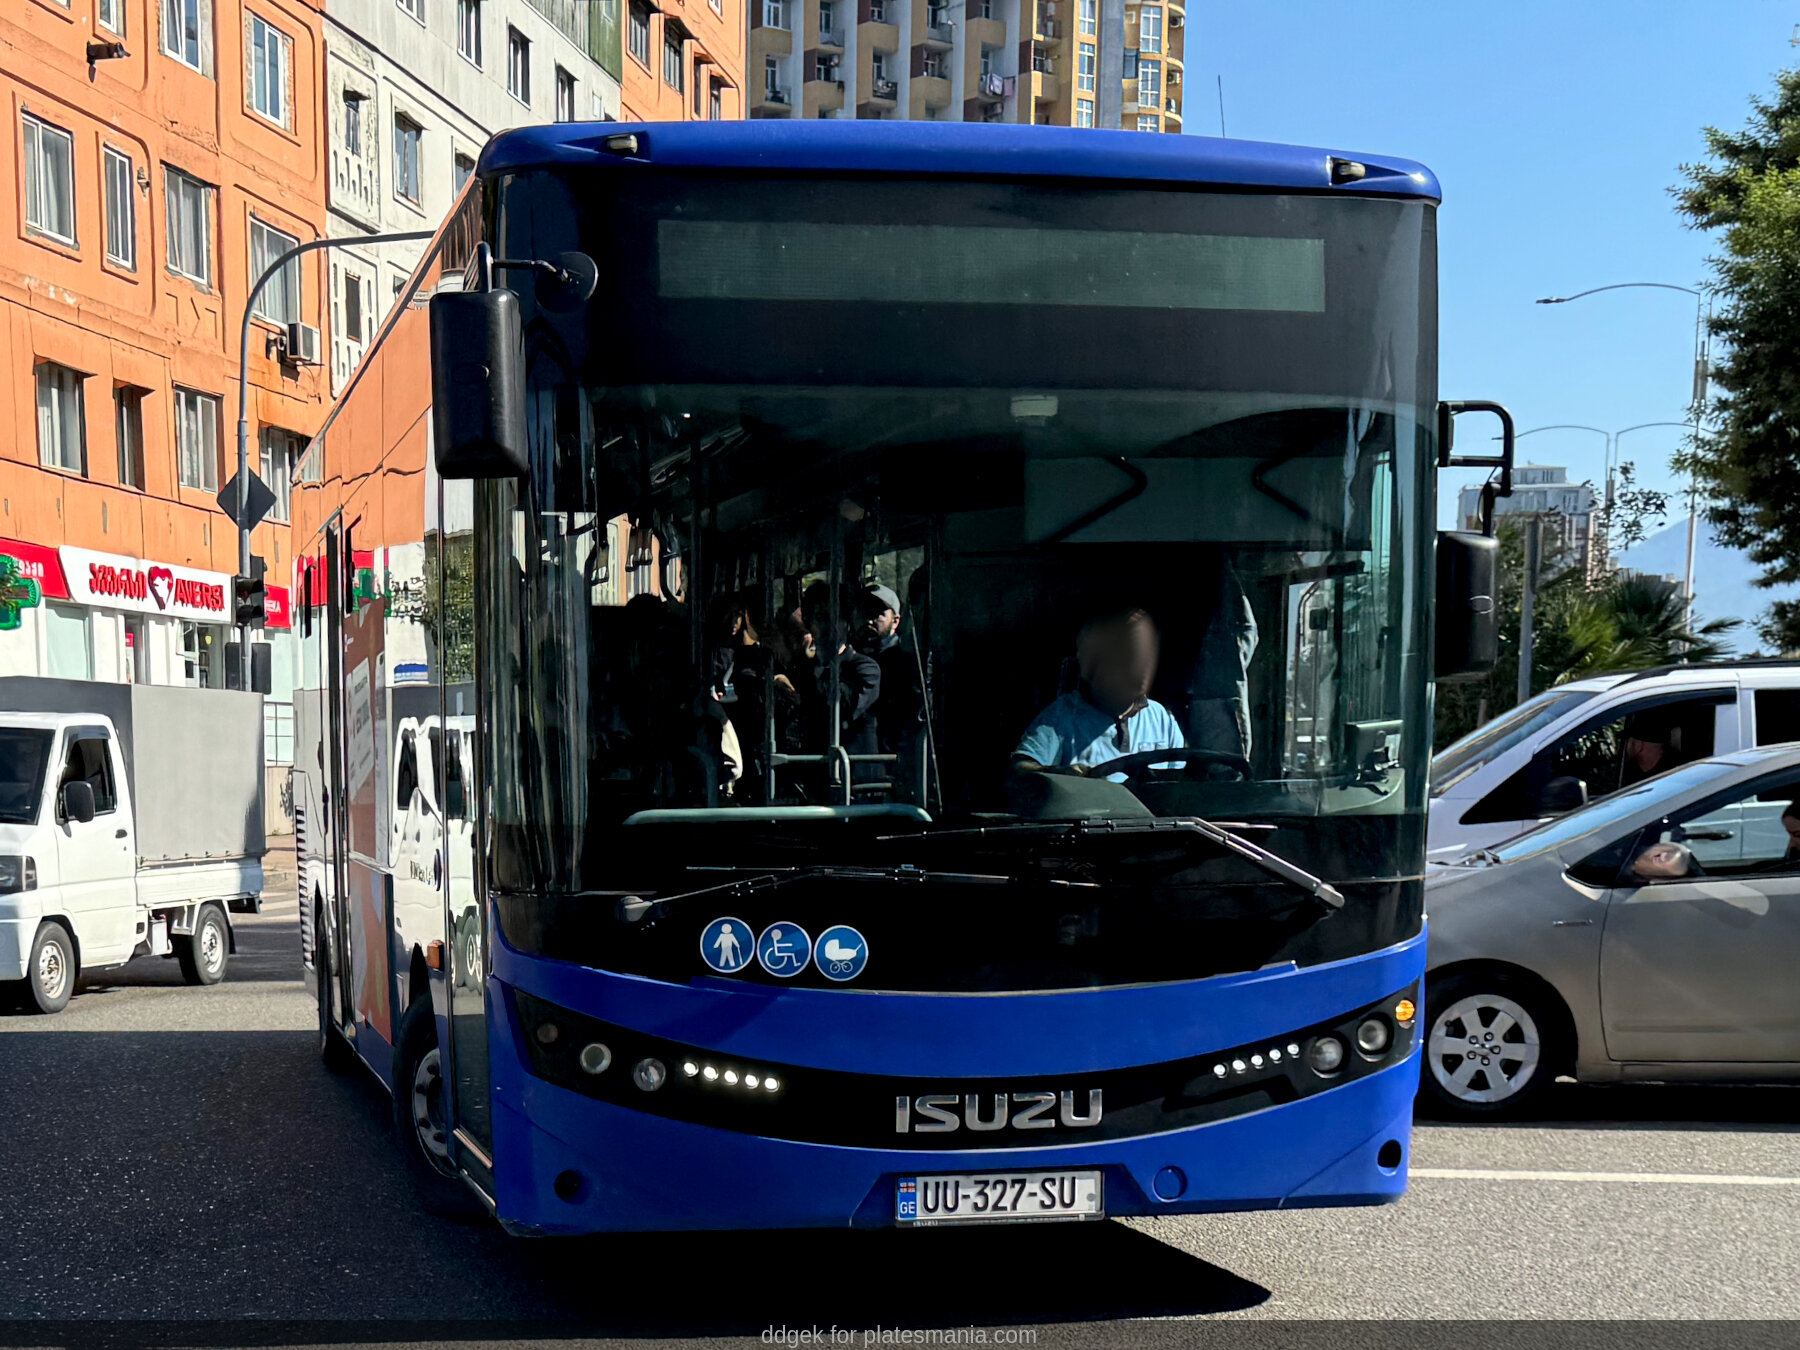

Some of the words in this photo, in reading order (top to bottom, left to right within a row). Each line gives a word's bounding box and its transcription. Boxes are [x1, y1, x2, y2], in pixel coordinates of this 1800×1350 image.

[174, 578, 225, 612] AVERSI
[895, 1089, 1102, 1133] ISUZU
[900, 1201, 916, 1214] GE
[922, 1176, 1077, 1214] UU-327-SU
